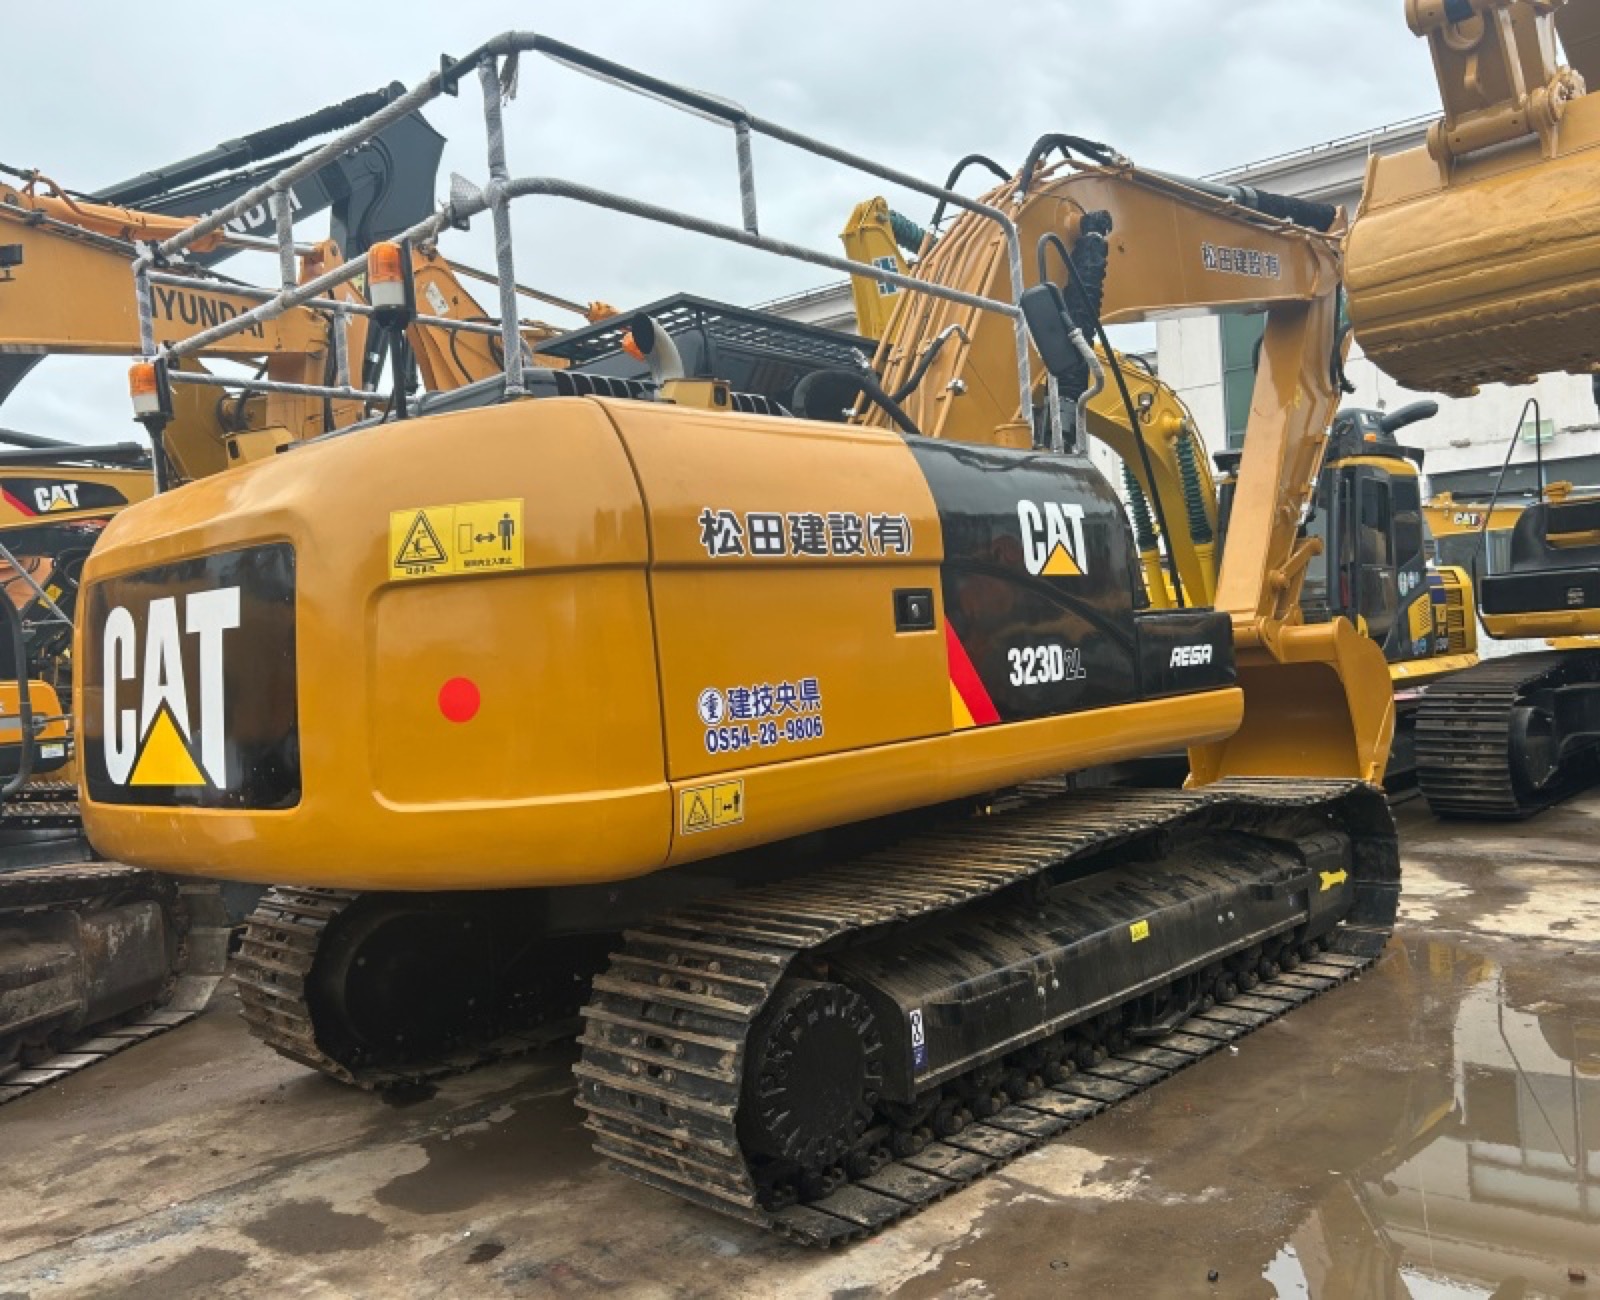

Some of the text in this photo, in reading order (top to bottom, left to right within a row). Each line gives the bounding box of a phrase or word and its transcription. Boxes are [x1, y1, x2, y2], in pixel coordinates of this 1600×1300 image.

[34, 483, 79, 512] CAT
[698, 507, 913, 558] 松田建設(有)
[1017, 500, 1089, 576] CAT
[103, 586, 241, 790] CAT
